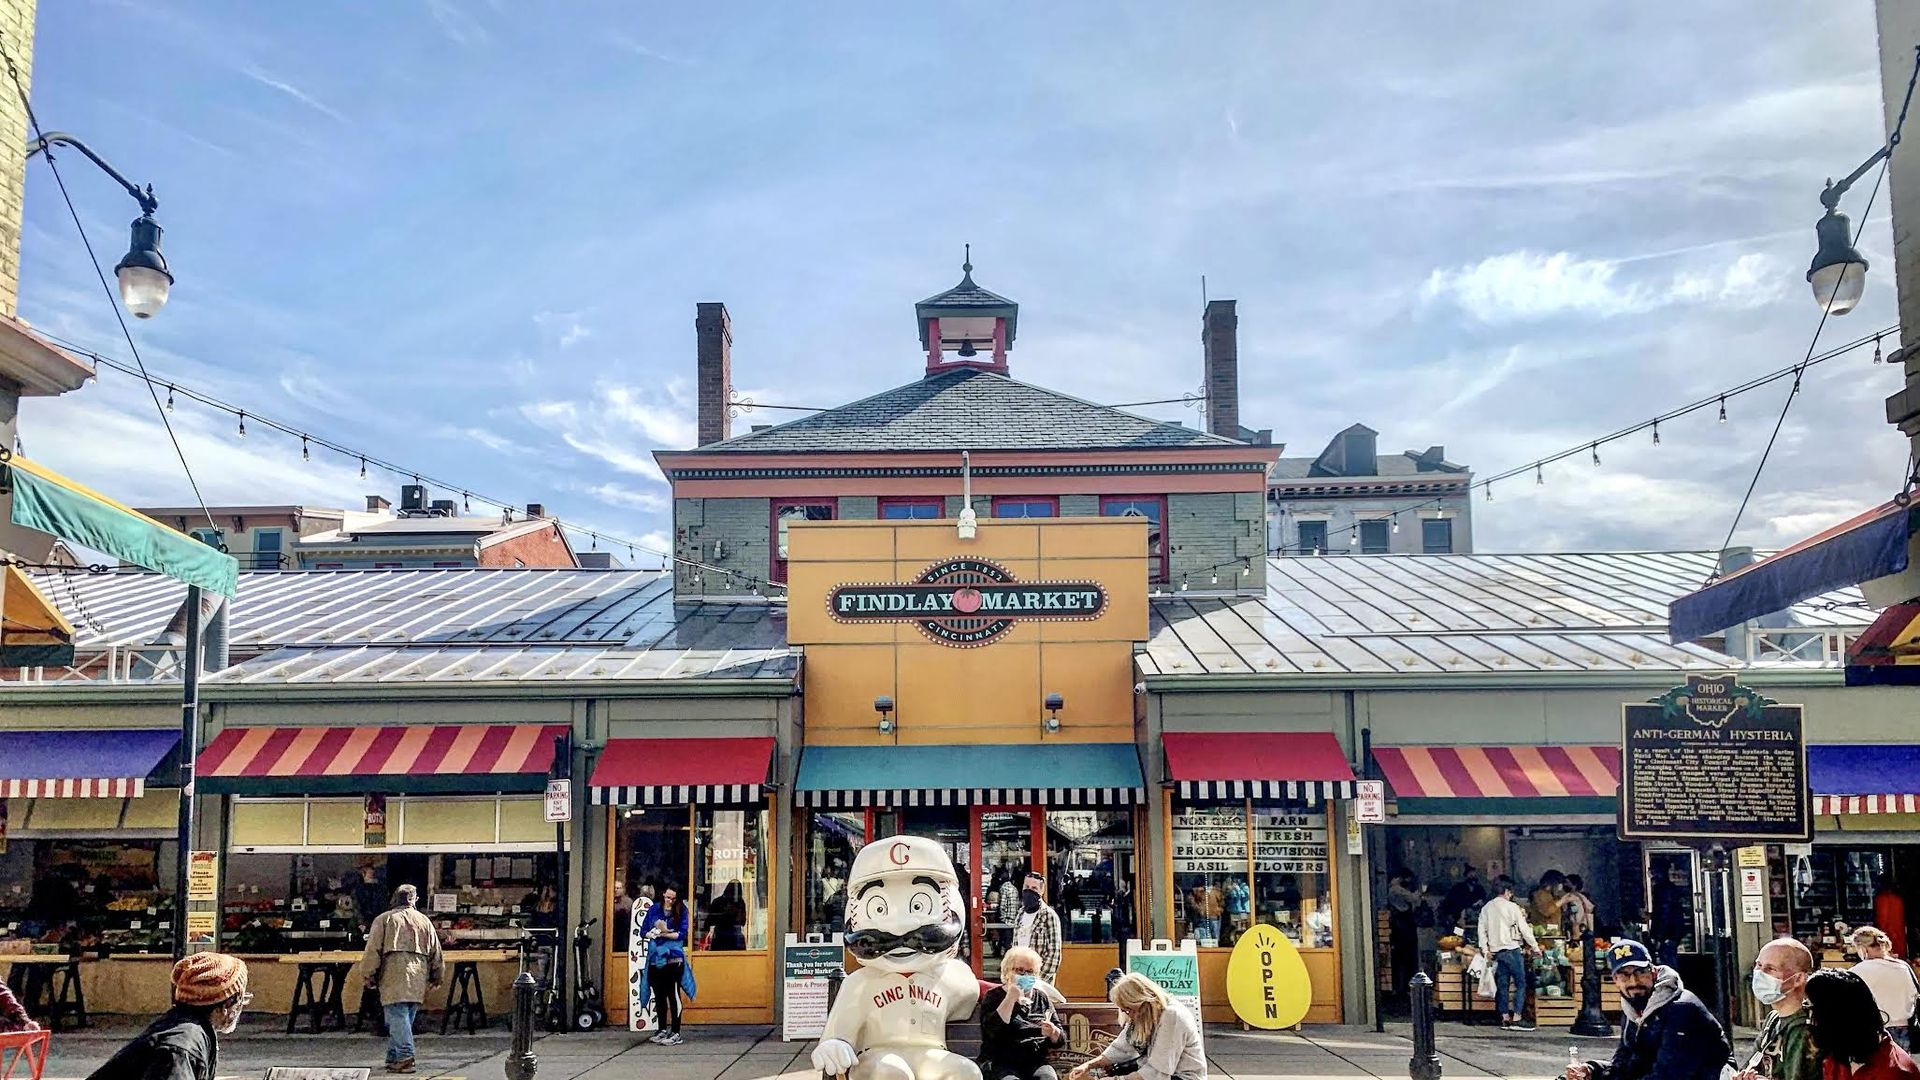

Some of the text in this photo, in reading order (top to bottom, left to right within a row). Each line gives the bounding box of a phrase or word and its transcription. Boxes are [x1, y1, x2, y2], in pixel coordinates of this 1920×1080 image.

[928, 562, 1003, 582] SINCE 1852
[838, 592, 1098, 611] FINDLAY MARKET
[928, 622, 1004, 640] CINCINNATI
[1698, 684, 1724, 694] OHIO
[1633, 729, 1793, 741] ANTI-GERMAN HYSTERIA
[1179, 816, 1206, 825] NON
[1270, 816, 1308, 826] FARM
[1191, 832, 1228, 841] EGGS
[1265, 832, 1312, 841] FRESH
[890, 842, 910, 865] C
[1177, 846, 1245, 855] PRODUCE
[1187, 862, 1228, 870] BASIL
[1254, 862, 1323, 871] FLOWERS
[1614, 944, 1632, 960] M
[1261, 951, 1277, 1019] OPEN
